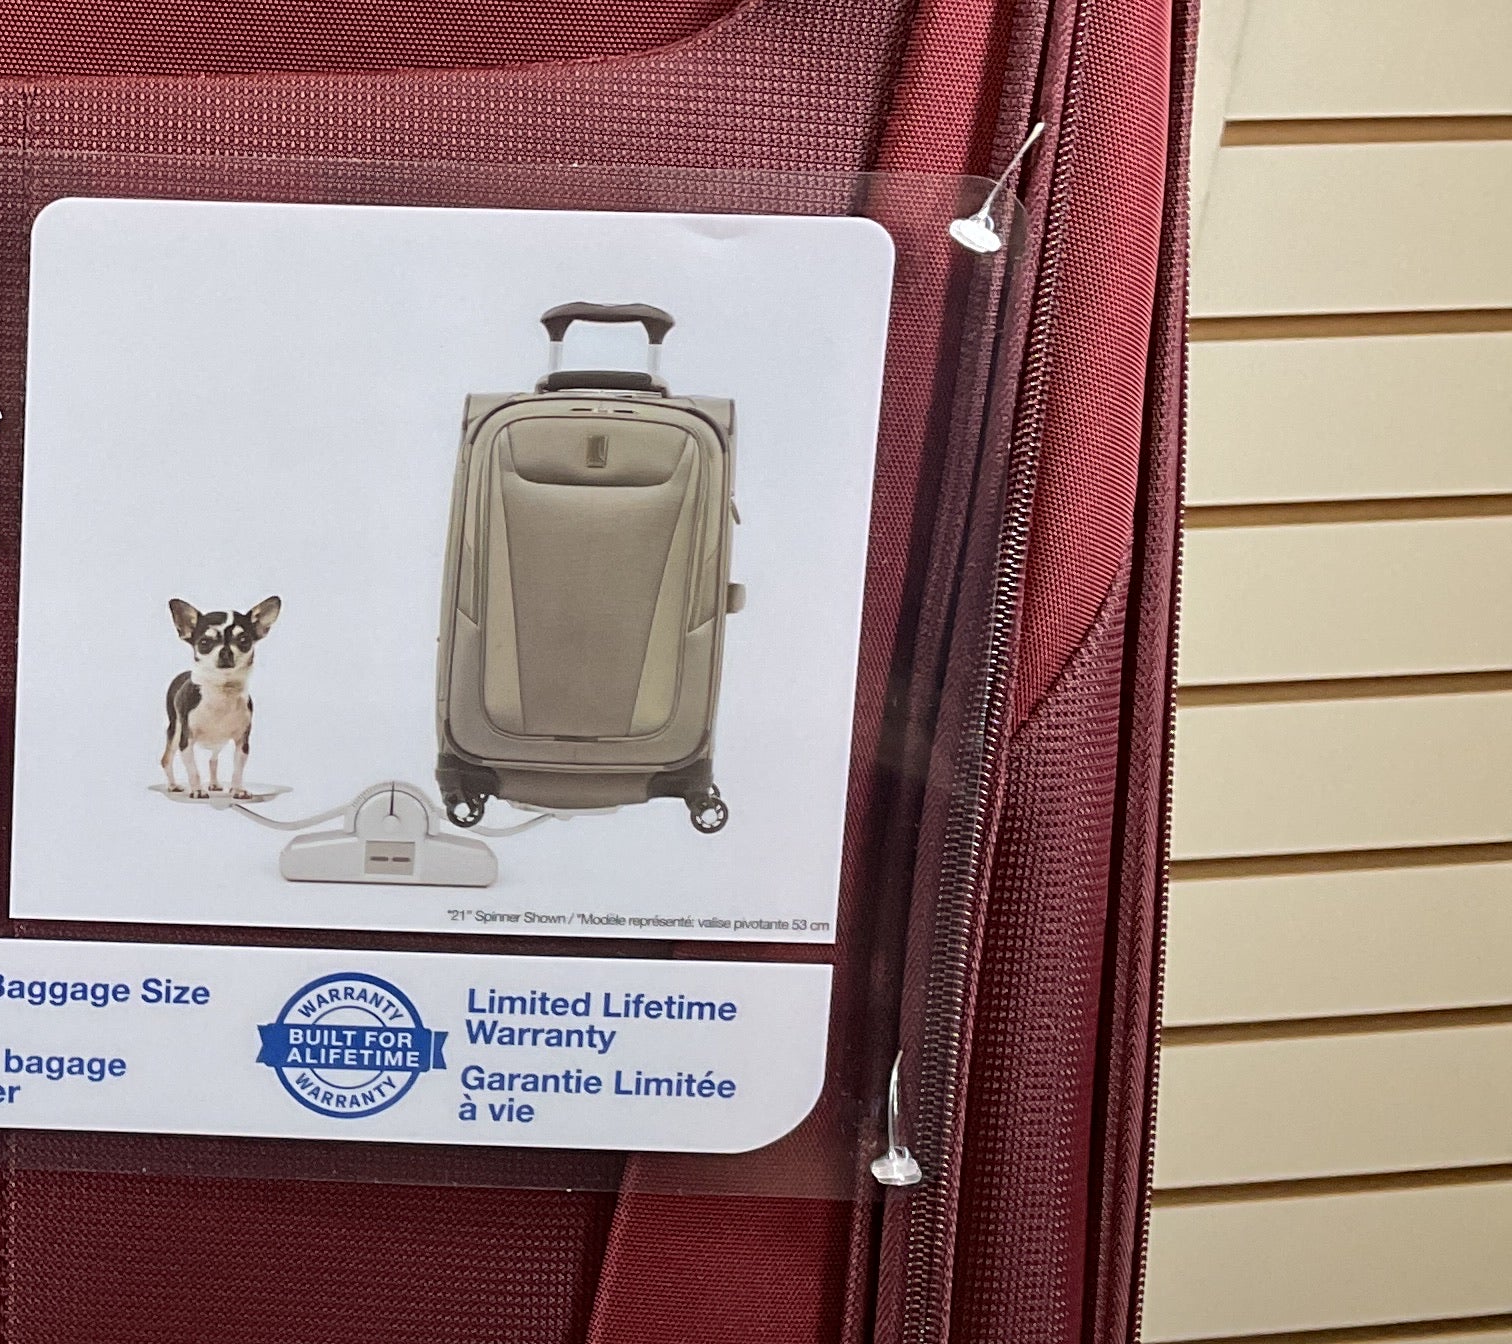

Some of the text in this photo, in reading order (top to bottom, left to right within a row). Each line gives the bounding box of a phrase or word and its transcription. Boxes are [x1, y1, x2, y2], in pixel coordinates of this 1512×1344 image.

[474, 910, 520, 924] Spinner
[523, 912, 566, 924] Shown
[698, 917, 731, 930] valise
[733, 918, 789, 932] pivotante
[791, 919, 808, 931] 53
[810, 921, 830, 931] cm
[140, 977, 210, 1005] Size
[297, 986, 404, 1023] WARRANTY
[466, 986, 739, 1024] Limited Lifetime
[289, 1028, 413, 1048] BUILT FOR
[464, 1018, 617, 1056] Warranty
[4, 1049, 127, 1082] bagage
[294, 1072, 398, 1109] WARRANTY
[459, 1064, 737, 1104] Garantie Limitée
[458, 1094, 536, 1126] à vie
